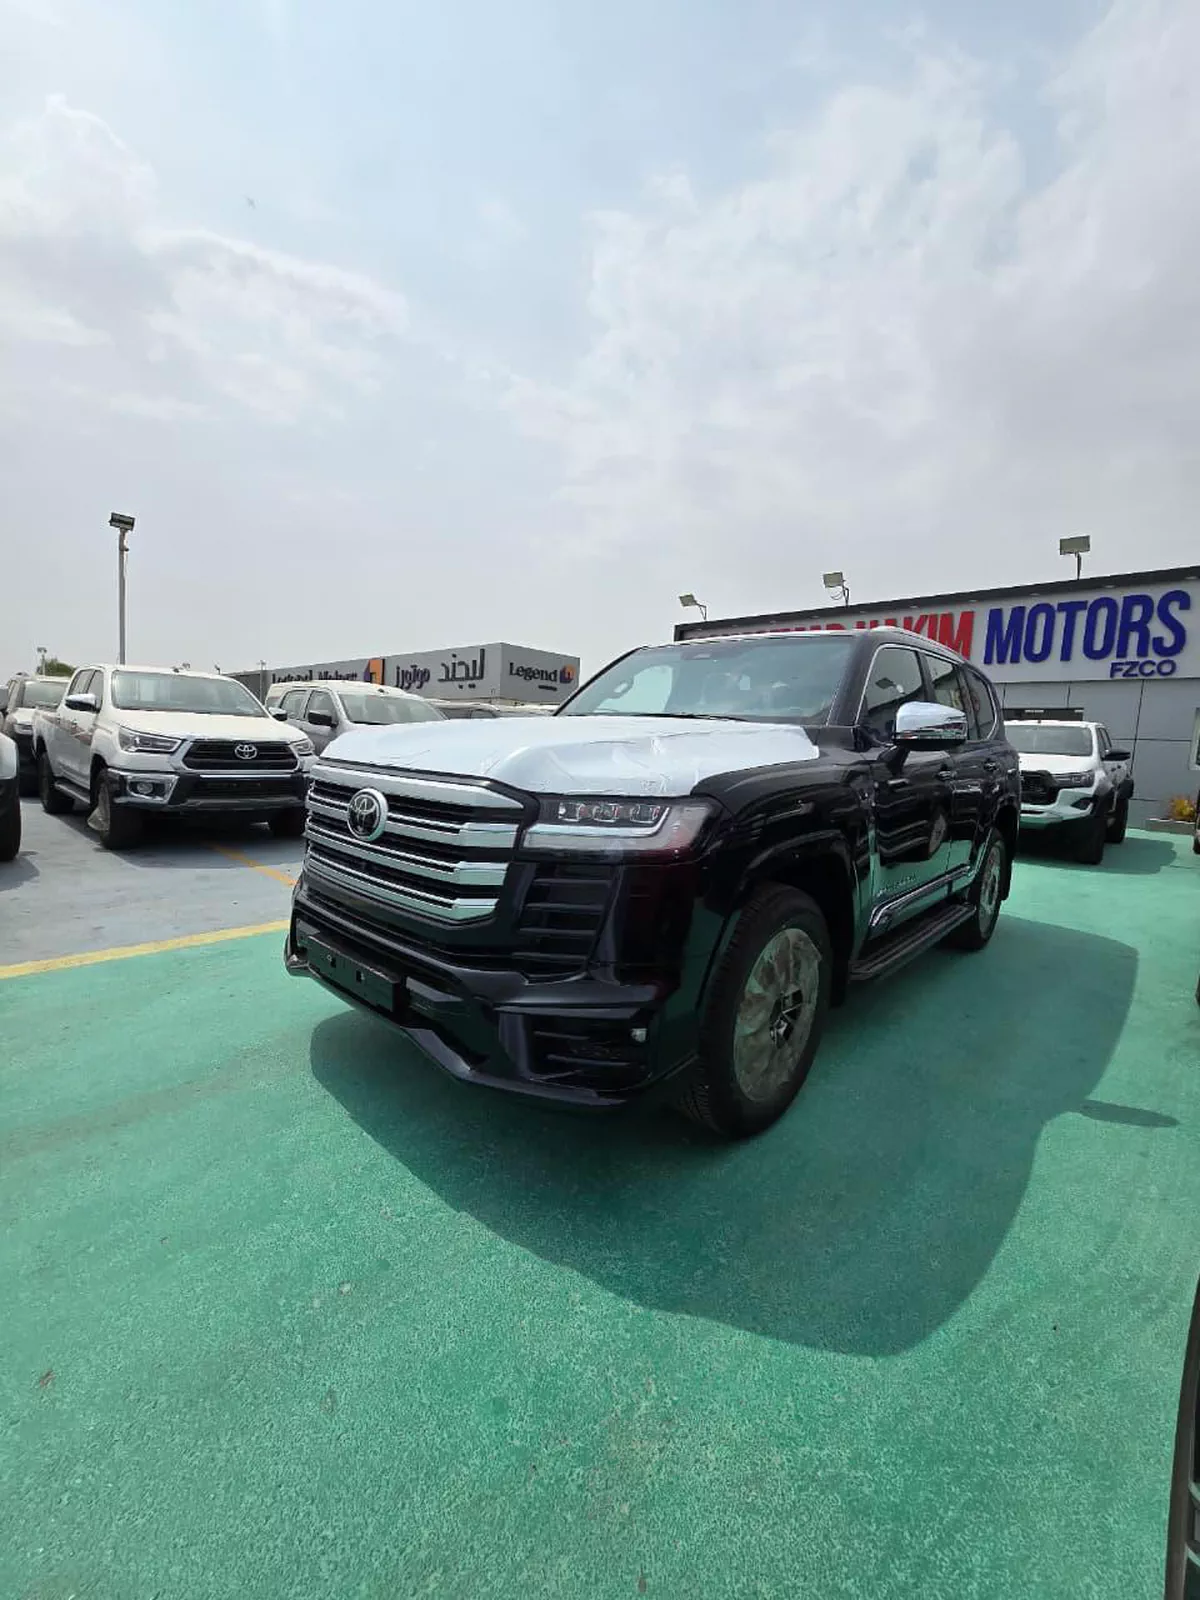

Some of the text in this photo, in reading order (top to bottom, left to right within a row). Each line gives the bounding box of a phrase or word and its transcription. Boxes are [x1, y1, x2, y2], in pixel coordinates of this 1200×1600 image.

[983, 590, 1191, 665] MOTORS
[437, 648, 485, 689] ليجند
[509, 662, 558, 682] Legend
[1109, 659, 1177, 679] FZCO
